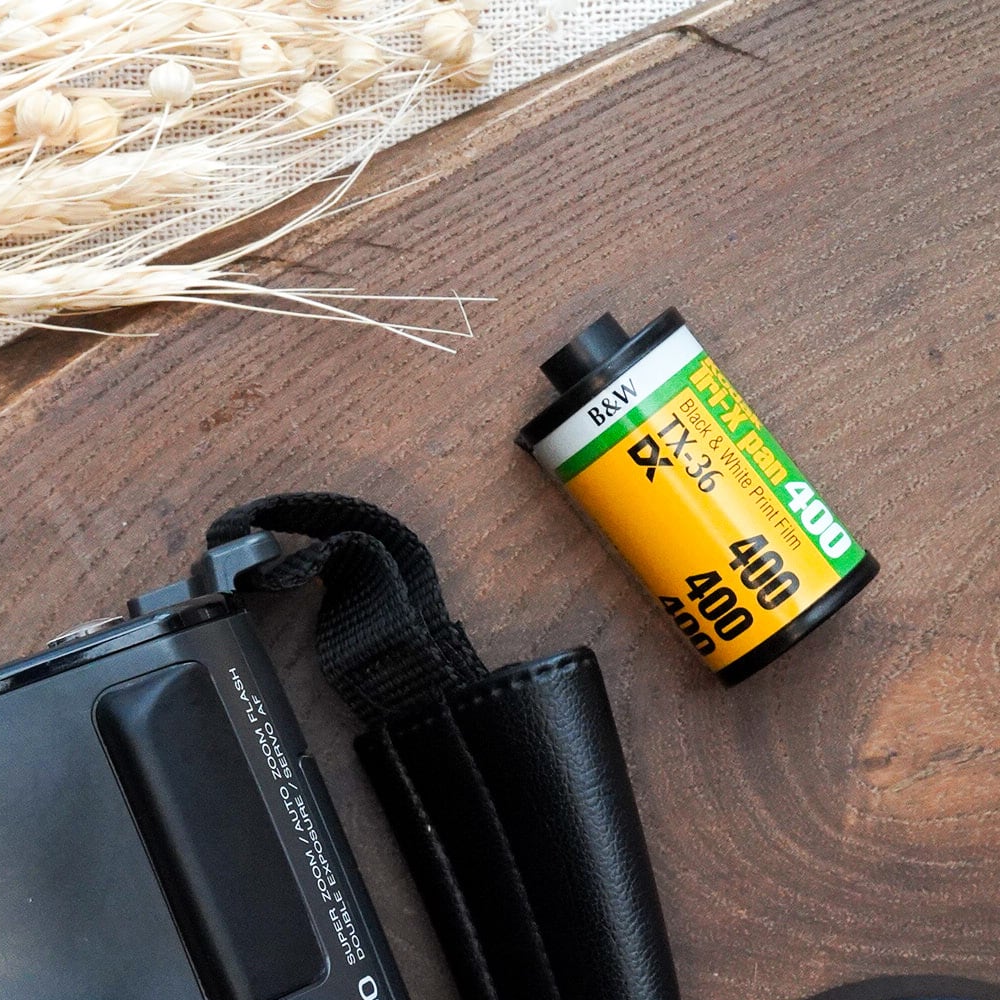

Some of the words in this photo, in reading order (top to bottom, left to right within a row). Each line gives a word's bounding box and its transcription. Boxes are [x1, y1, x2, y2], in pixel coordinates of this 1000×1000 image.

[587, 378, 638, 427] B&W
[657, 412, 724, 493] TX-36
[680, 398, 711, 438] Black
[709, 435, 724, 451] &
[720, 448, 752, 490] White
[749, 485, 779, 522] Print
[774, 517, 802, 551] Film
[735, 430, 788, 487] pan
[784, 481, 851, 559] 400
[729, 534, 800, 611] 400
[658, 596, 716, 656] 400
[685, 570, 754, 641] 400
[229, 667, 258, 723] FLASH
[251, 695, 267, 715] AF
[255, 728, 282, 780] ZOOM
[264, 722, 292, 778] SERVO
[280, 786, 304, 832] AUTO
[295, 795, 336, 886] EXPOSURE
[305, 850, 331, 902] ZOOM
[329, 907, 356, 965] SUPER
[334, 890, 365, 960] DOUBLE
